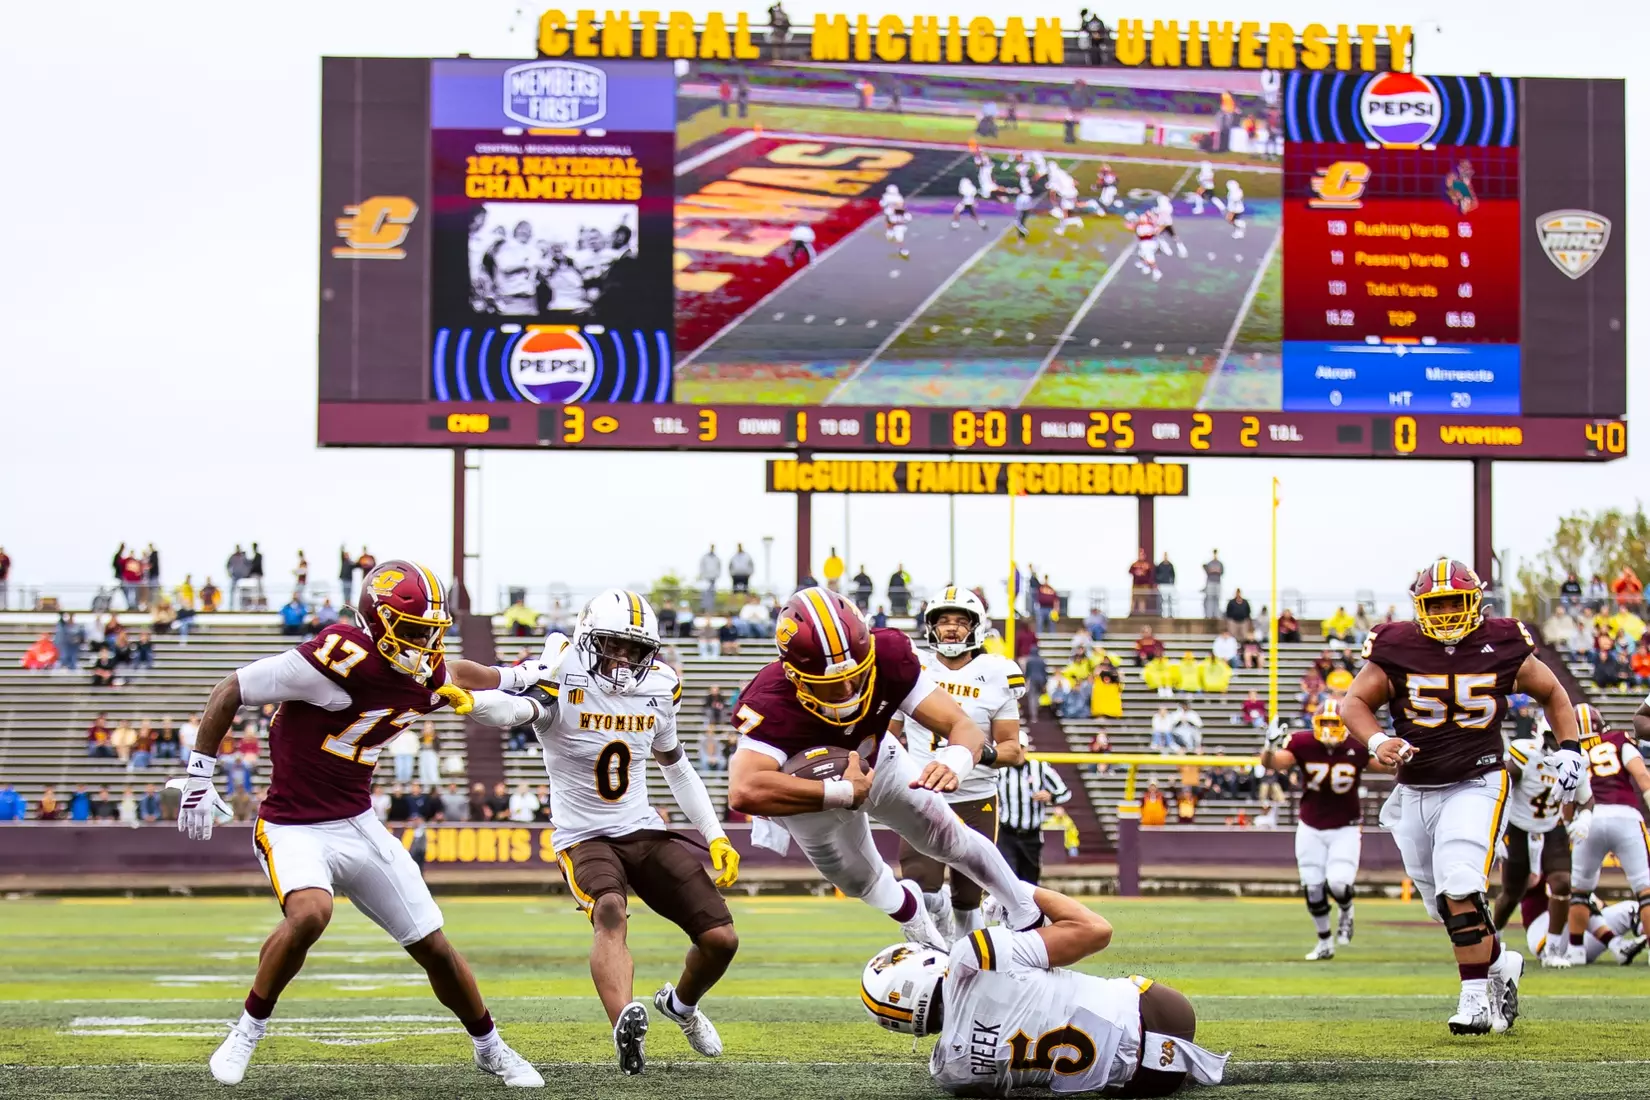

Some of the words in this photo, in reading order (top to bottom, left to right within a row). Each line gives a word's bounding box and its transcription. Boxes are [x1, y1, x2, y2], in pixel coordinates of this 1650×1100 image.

[538, 9, 760, 60] CENTRAL
[811, 13, 1064, 64] MICHIGAN
[1115, 18, 1413, 71] UNIVERSITY
[1368, 101, 1434, 116] PEPSI
[522, 156, 643, 177] NATIONAL
[465, 175, 643, 200] CHAMPIONS
[1354, 221, 1411, 240] Rushing
[1411, 223, 1449, 238] Yards
[1355, 251, 1410, 269] Passing
[1409, 252, 1449, 268] Yards
[1365, 281, 1399, 297] Total
[1399, 282, 1438, 297] Yards
[519, 359, 588, 374] PEPSI
[1315, 365, 1356, 380] Akron
[1425, 367, 1495, 382] Minnesota
[1388, 391, 1413, 406] HT
[1451, 392, 1472, 408] 20
[563, 405, 585, 443] 3
[698, 409, 718, 442] 3
[738, 418, 781, 435] DOWN
[796, 411, 807, 443] 1
[818, 418, 838, 435] TO
[838, 418, 860, 436] GO
[875, 408, 911, 446] 10
[1086, 411, 1135, 449] 25
[1190, 412, 1213, 450] 2
[1240, 415, 1260, 447] 2
[1394, 416, 1417, 453] 0
[1439, 425, 1523, 445] WYOMING
[1585, 421, 1626, 453] 40
[772, 459, 899, 491] McGUIRK
[905, 461, 1001, 493] FAMILY
[1006, 463, 1183, 495] SCOREBOARD
[312, 633, 369, 678] 17
[1403, 673, 1497, 729] 55
[579, 712, 655, 732] WYOMING
[736, 703, 765, 734] 7
[594, 739, 632, 803] 0
[1305, 762, 1356, 794] 76
[914, 999, 928, 1036] Riddell
[971, 1019, 1001, 1077] CHEEK
[1008, 1021, 1097, 1077] 5
